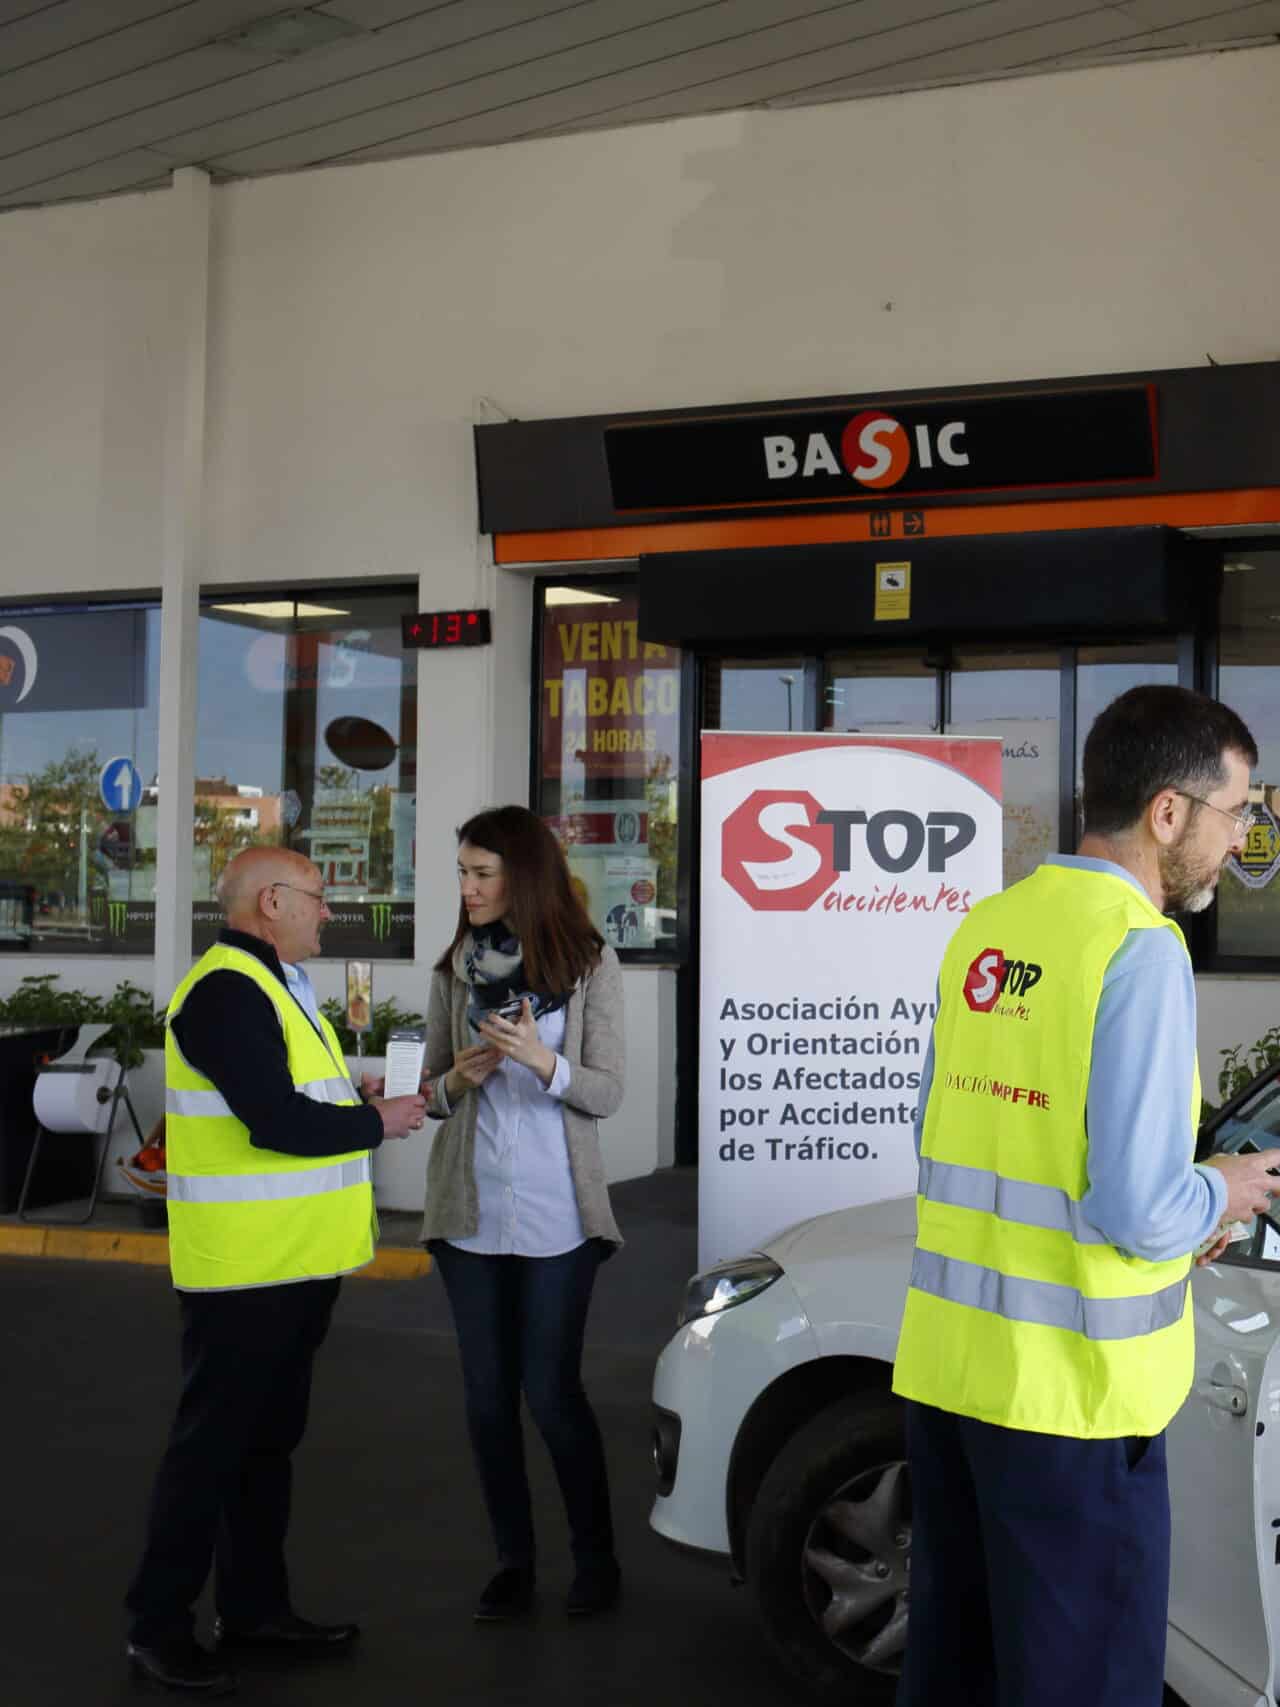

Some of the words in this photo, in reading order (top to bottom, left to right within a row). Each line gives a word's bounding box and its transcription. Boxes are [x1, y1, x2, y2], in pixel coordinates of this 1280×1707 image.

[763, 418, 970, 481] BASIC
[544, 674, 679, 718] TABACO
[593, 728, 657, 752] HORAS
[741, 801, 977, 891] STOP
[823, 879, 971, 914] accidentes
[971, 954, 1042, 1003] STOP
[719, 996, 879, 1021] Asociación
[719, 1038, 736, 1061] y
[746, 1031, 920, 1056] Orientación
[719, 1068, 762, 1091] los
[772, 1066, 921, 1090] Afectados
[719, 1107, 769, 1132] por
[718, 1138, 755, 1161] de
[765, 1136, 878, 1160] Tráfico.
